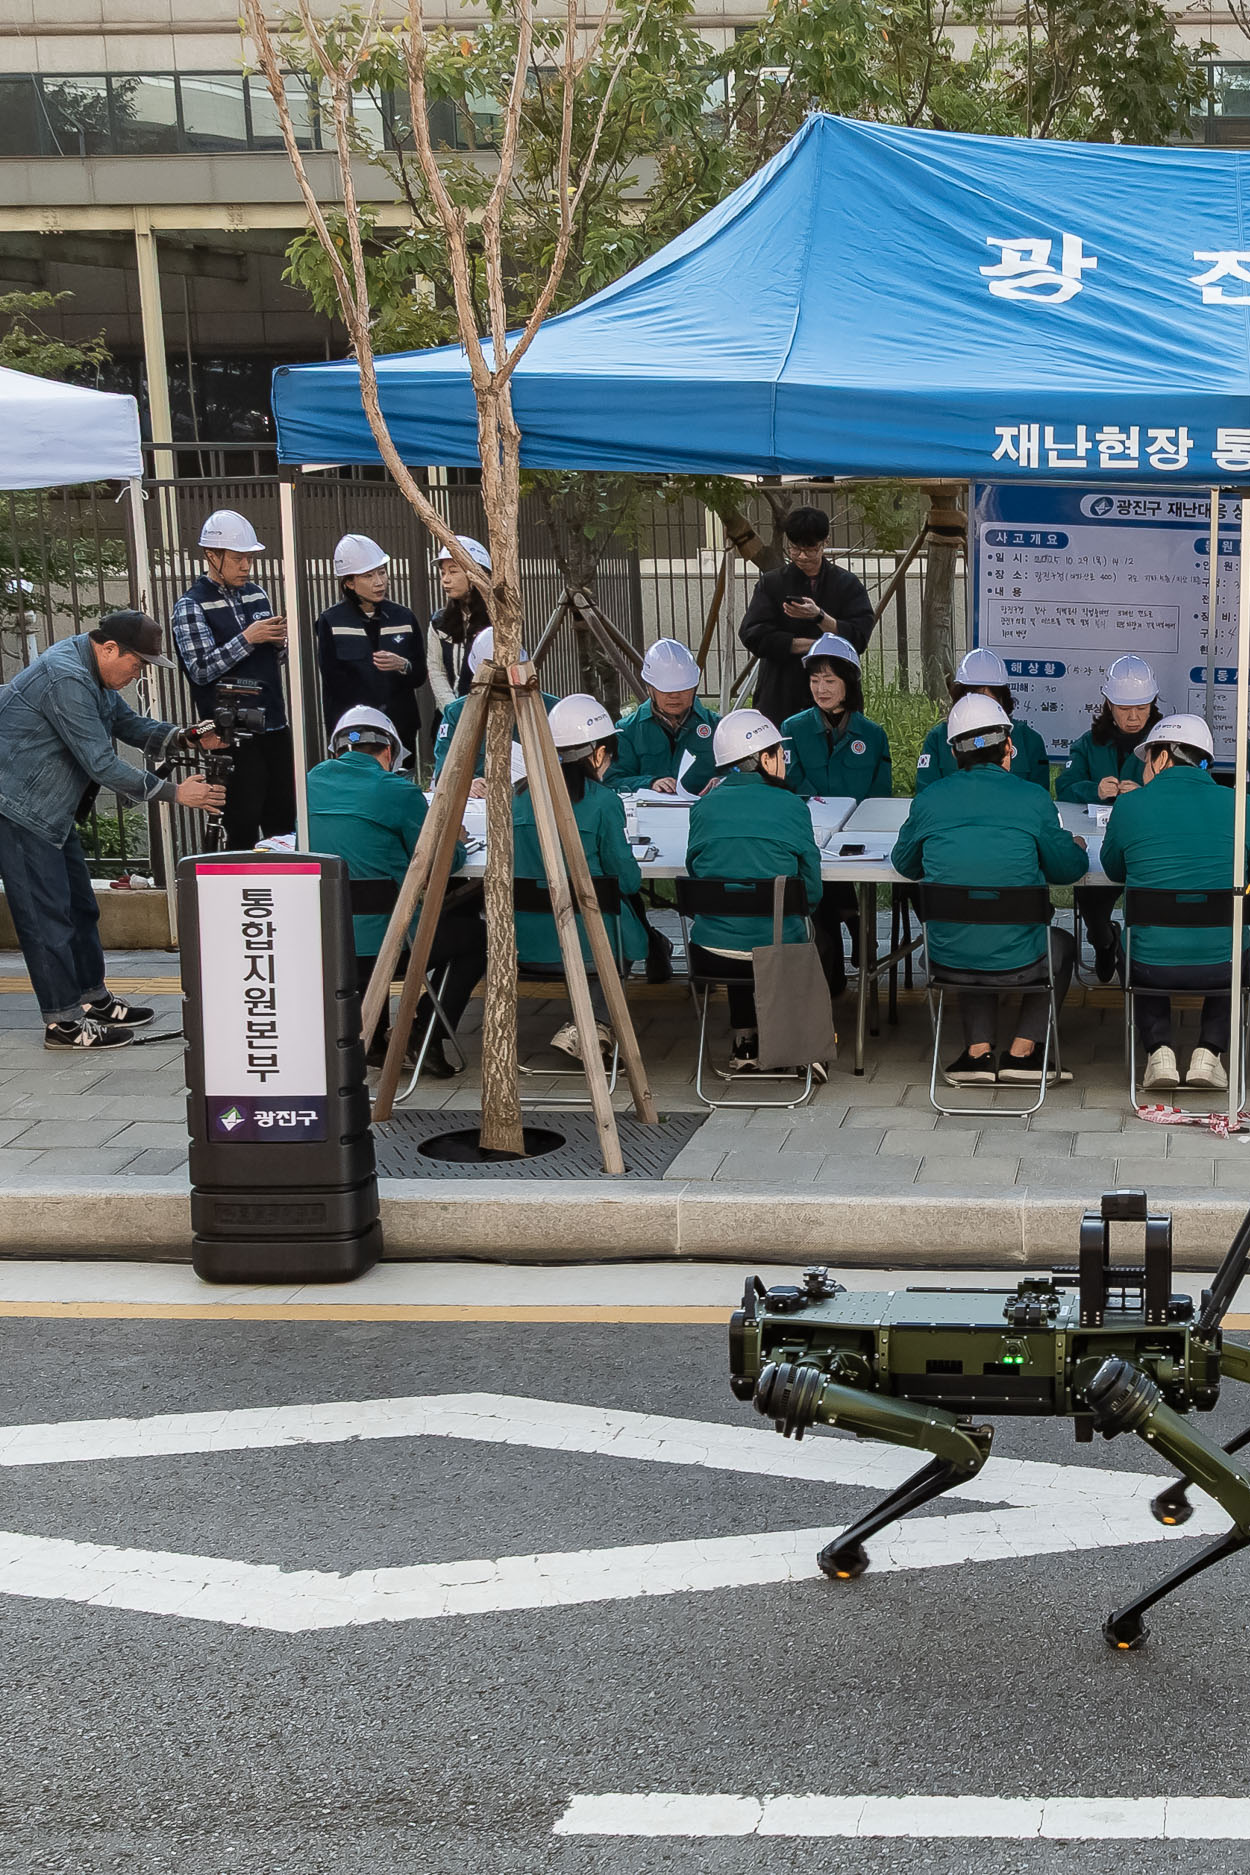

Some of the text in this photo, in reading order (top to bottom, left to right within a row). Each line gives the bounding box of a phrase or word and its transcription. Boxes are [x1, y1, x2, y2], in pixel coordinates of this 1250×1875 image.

[992, 423, 1194, 469] 재난현장
[1117, 500, 1162, 516] 광진구
[996, 532, 1058, 545] 사고개요
[1011, 662, 1055, 675] 해상황
[240, 888, 280, 1083] 통합지원본부
[253, 1110, 318, 1128] 광진구
